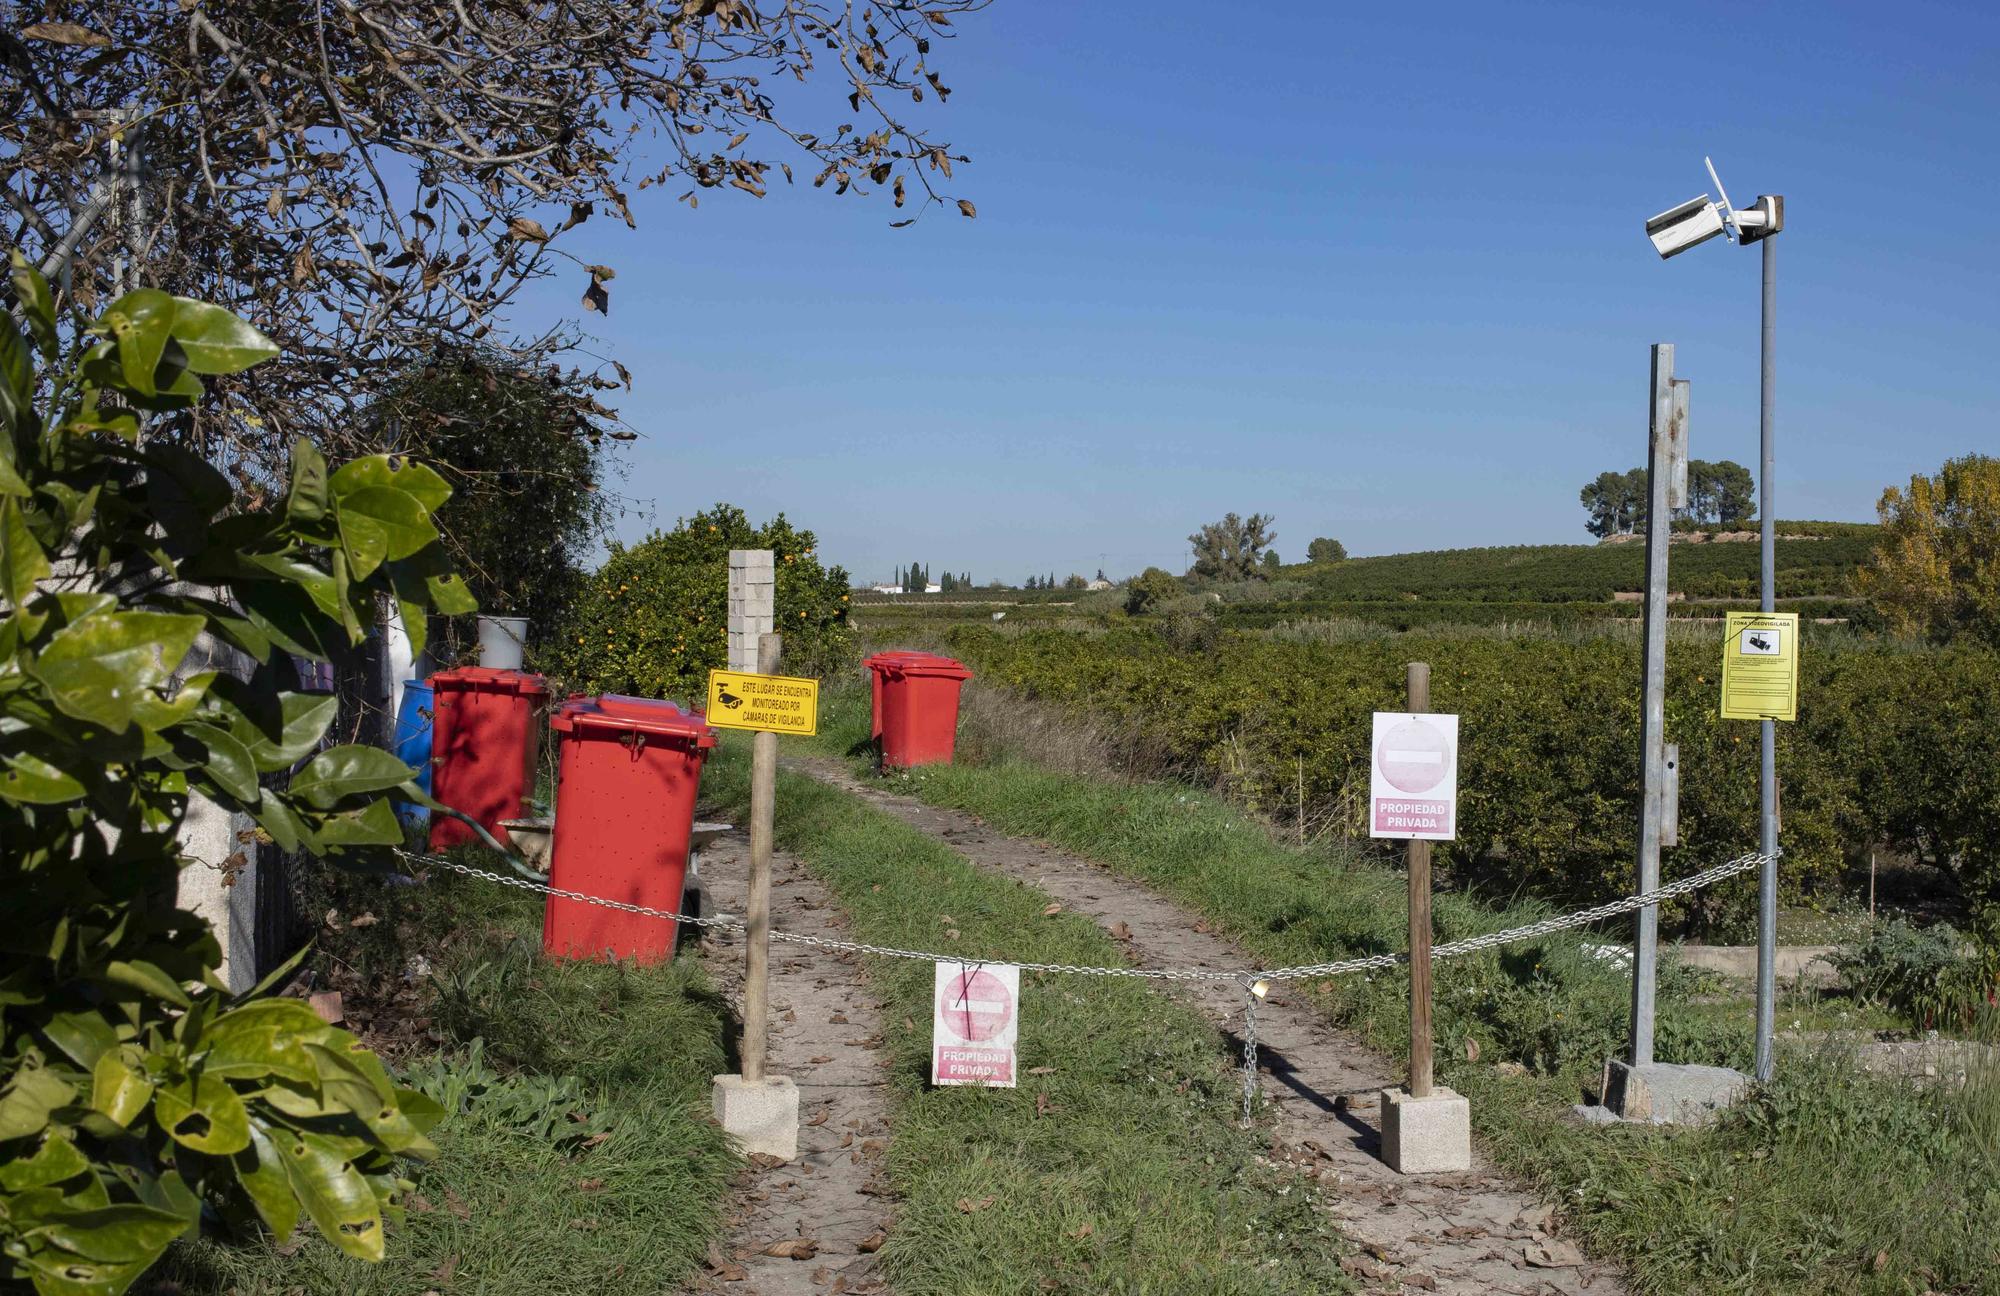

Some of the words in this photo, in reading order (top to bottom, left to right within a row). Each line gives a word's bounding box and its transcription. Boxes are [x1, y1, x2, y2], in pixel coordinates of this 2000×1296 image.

[742, 682, 756, 693] ESTE
[757, 683, 775, 695] LUGAR
[776, 685, 783, 696] SE
[784, 686, 811, 698] ENCUENTRA
[752, 697, 789, 711] MONITOREADO
[790, 701, 800, 712] POR
[769, 714, 777, 724] DE
[778, 714, 805, 726] VIGILANCIA
[1380, 803, 1445, 815] PROPIEDAD
[1387, 817, 1437, 828] PRIVADA
[943, 1050, 1007, 1064] PROPIEDAD
[950, 1064, 999, 1076] PRIVADA
